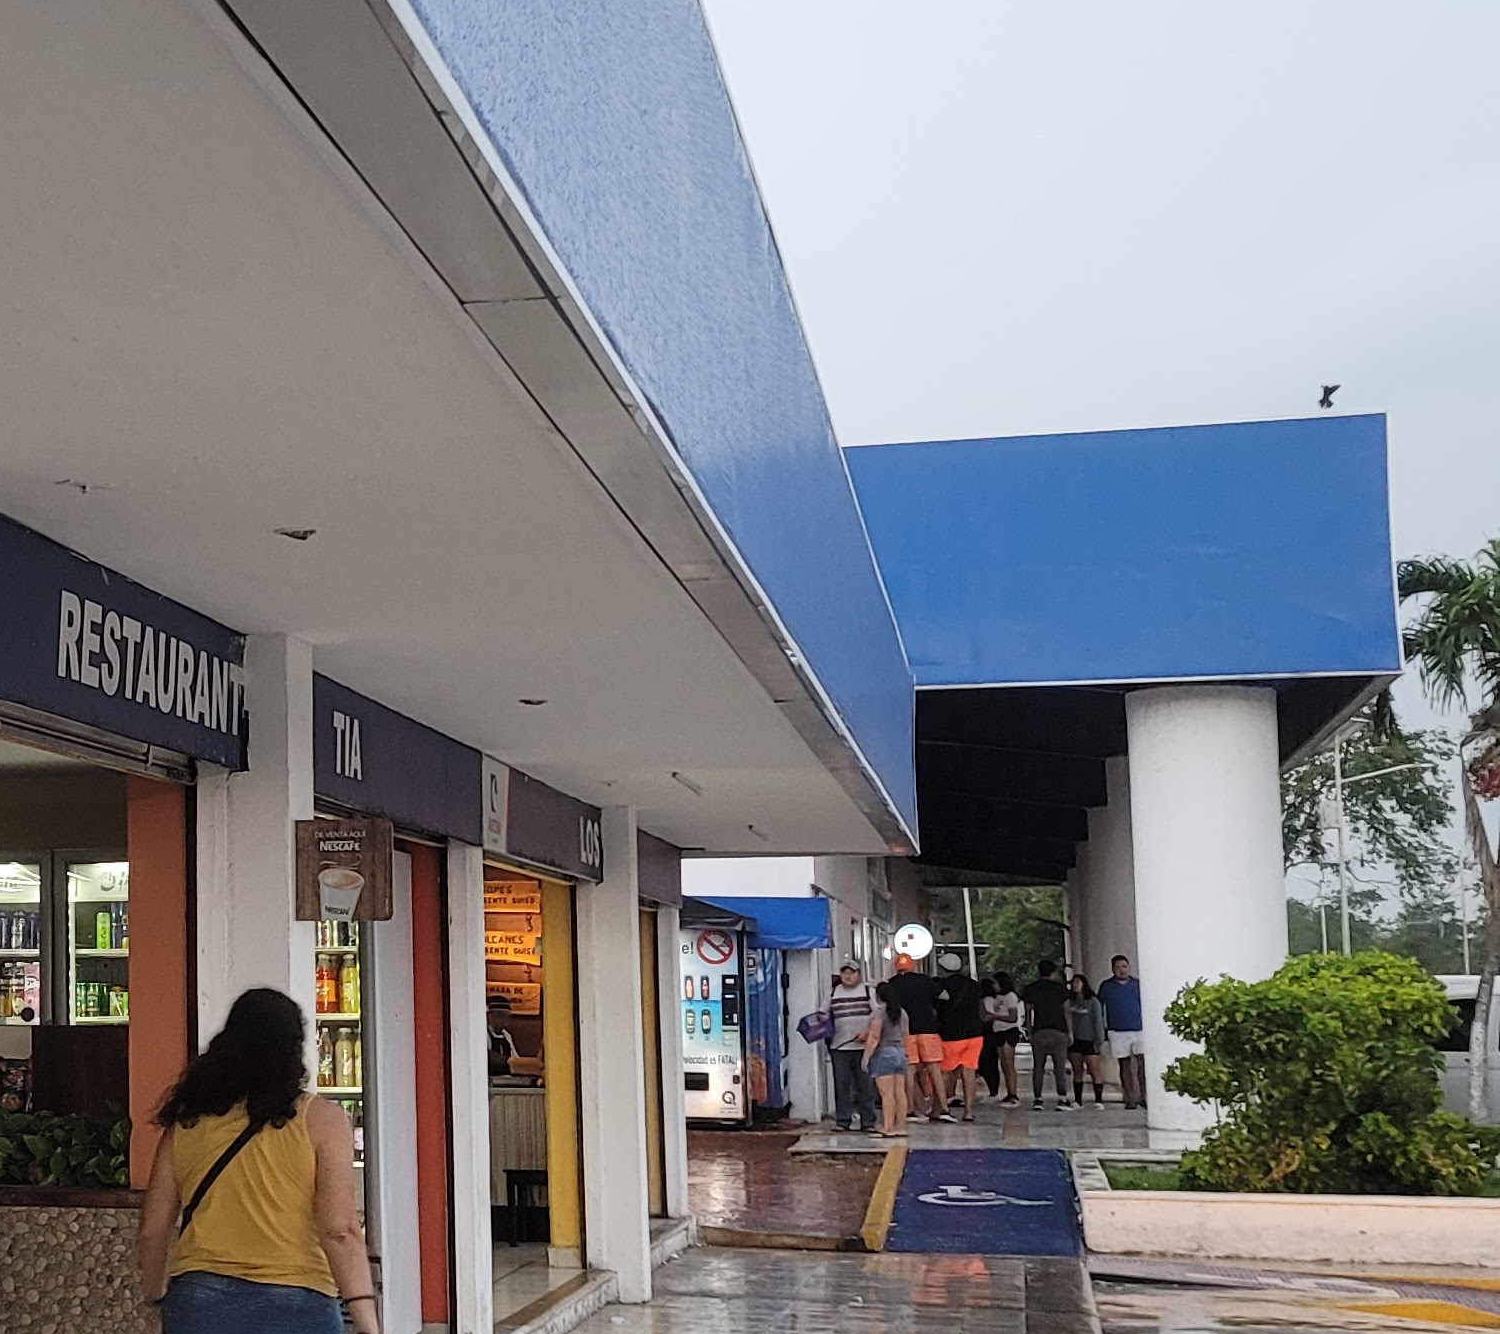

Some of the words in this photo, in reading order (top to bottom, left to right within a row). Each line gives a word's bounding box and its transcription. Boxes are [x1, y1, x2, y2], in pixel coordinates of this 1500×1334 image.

[58, 589, 244, 736] RESTAURANT
[333, 710, 362, 781] TIA
[325, 830, 348, 838] VENTA
[580, 816, 599, 868] LOS
